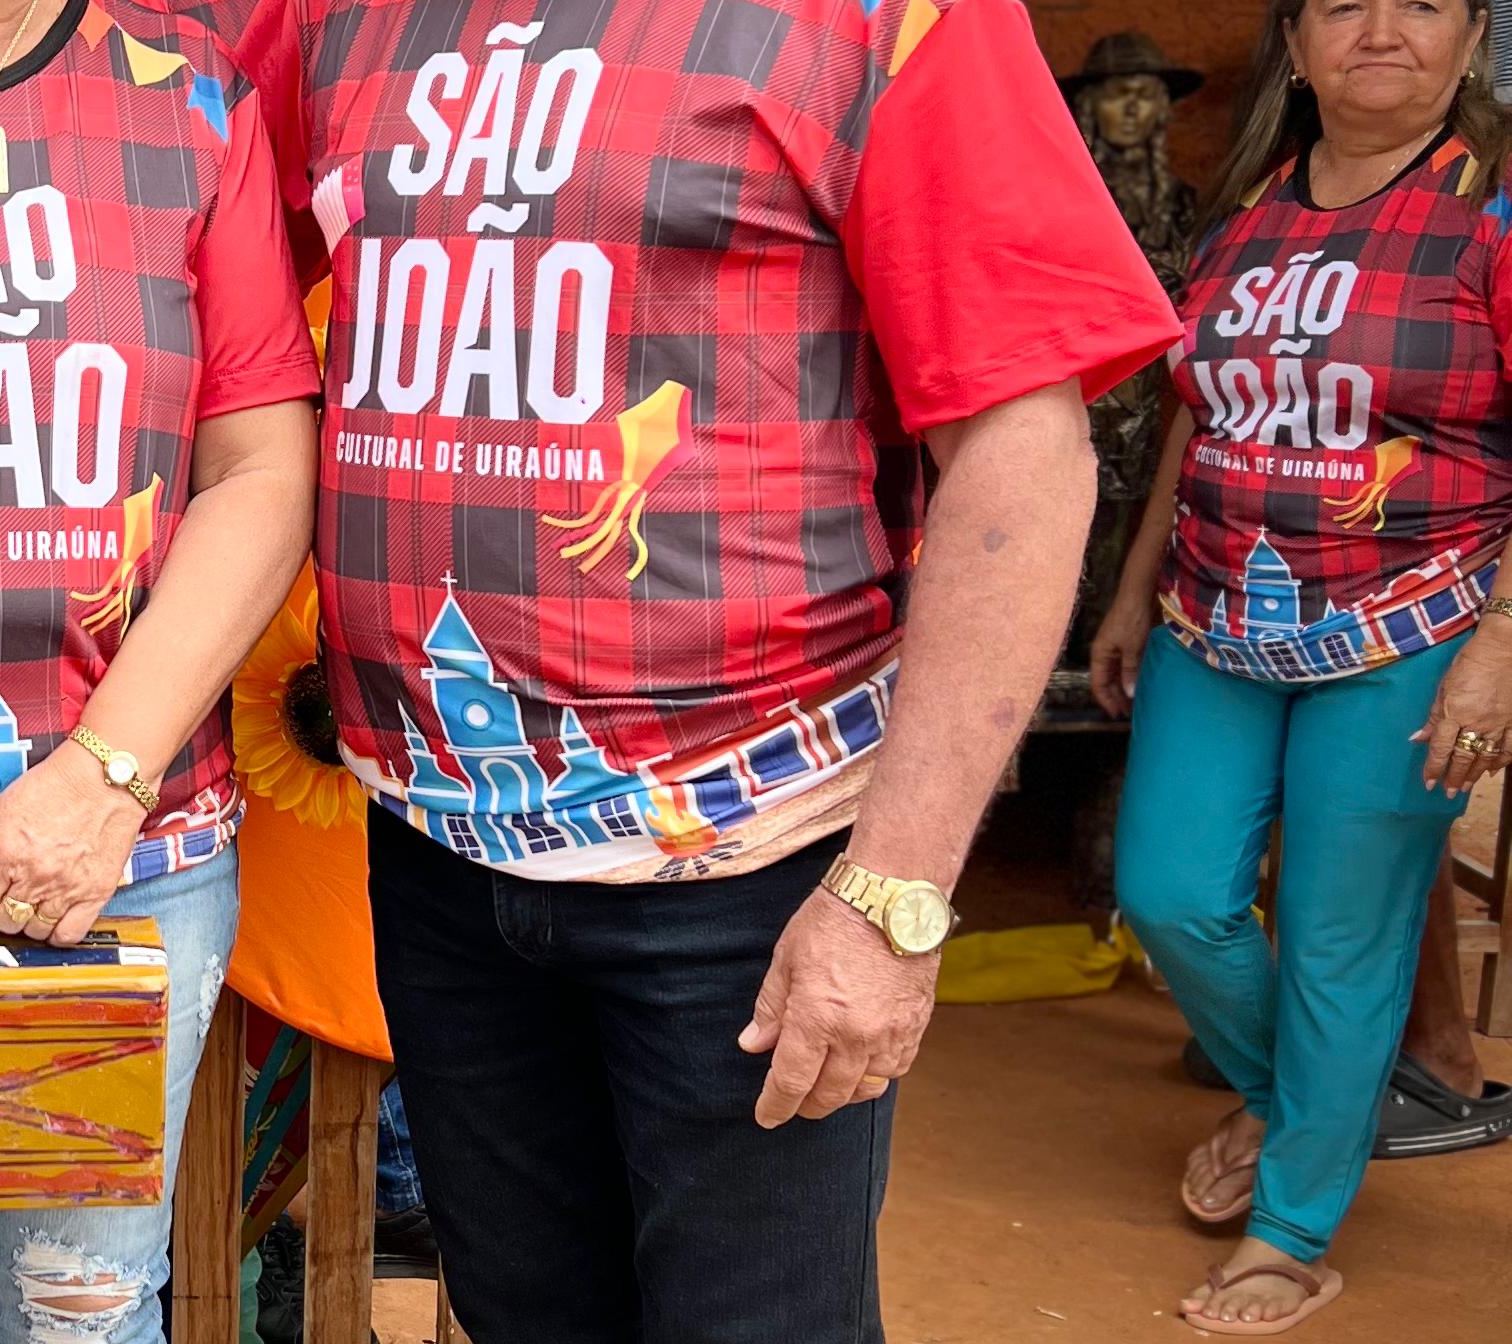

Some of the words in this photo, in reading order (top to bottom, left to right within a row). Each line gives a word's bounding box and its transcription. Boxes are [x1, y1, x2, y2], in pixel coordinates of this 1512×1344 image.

[388, 21, 603, 196] SÃO
[342, 202, 614, 425] JOÃO
[1215, 250, 1359, 337] SÃO
[1194, 338, 1373, 450] JOÃO
[336, 430, 425, 471] CULTURAL
[435, 440, 464, 473] DE
[475, 442, 605, 481] UIRAÚNA
[1195, 445, 1250, 472] CULTURAL
[1255, 457, 1275, 474] DE
[1282, 458, 1365, 481] UIRAÚNA
[7, 524, 119, 561] UIRAÚNA
